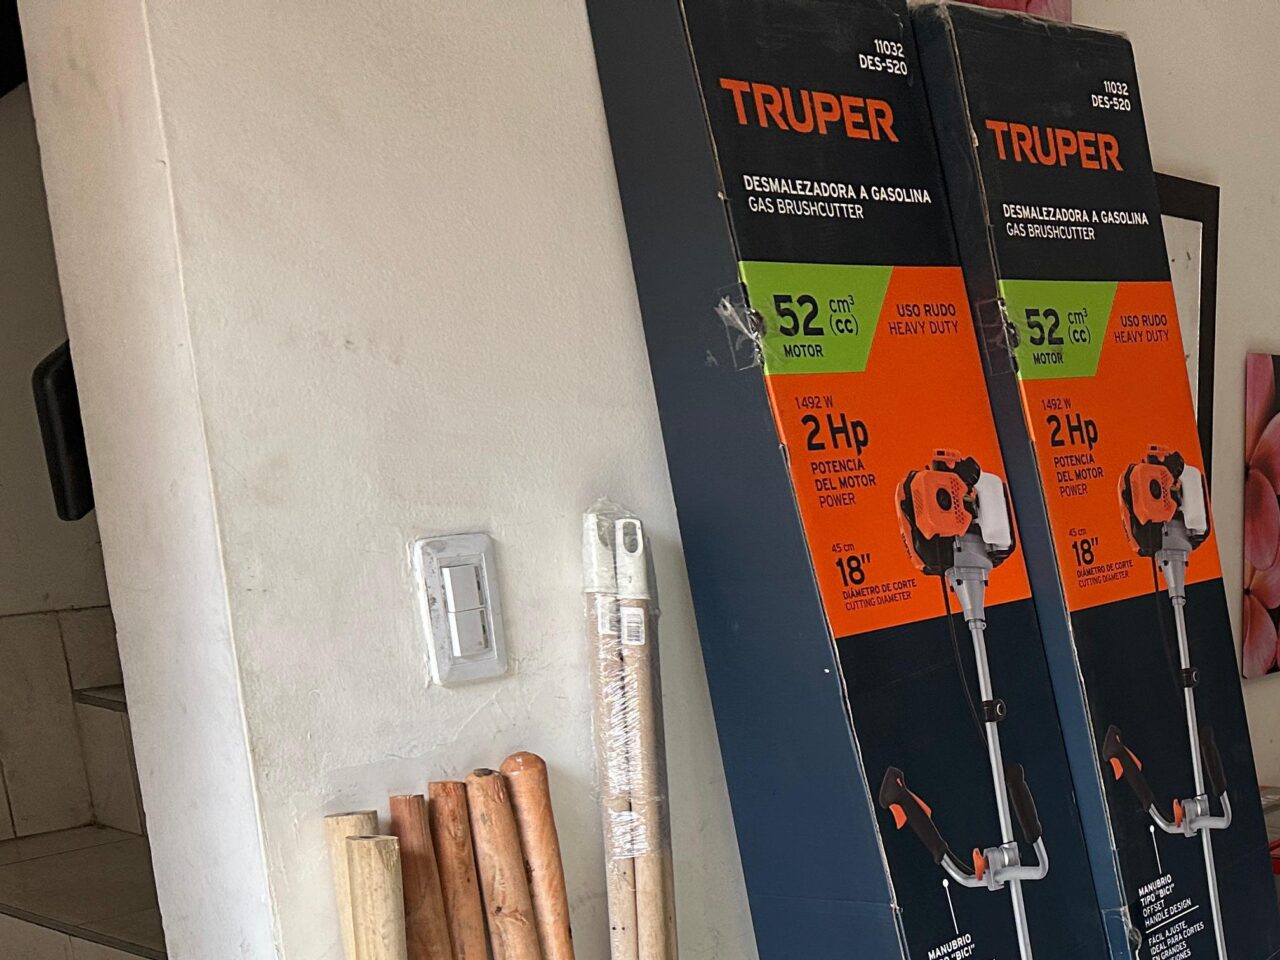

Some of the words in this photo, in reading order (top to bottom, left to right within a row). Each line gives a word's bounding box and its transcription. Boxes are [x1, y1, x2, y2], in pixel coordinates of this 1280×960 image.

[874, 39, 905, 58] 11032
[859, 54, 908, 75] DES-520
[1103, 80, 1129, 96] 11032
[719, 77, 900, 142] TRUPER
[1091, 94, 1132, 112] DES-520
[985, 119, 1124, 172] TRUPER
[743, 174, 855, 200] DESMALEZADORA
[859, 185, 869, 199] A
[871, 187, 932, 204] GASOLINA
[748, 196, 774, 213] GAS
[777, 198, 864, 219] BRUSHCUTTER
[1002, 203, 1089, 223] DESMALEZADORA
[1092, 210, 1099, 223] A
[1100, 211, 1149, 226] GASOLINA
[1006, 222, 1026, 237] GAS
[1028, 225, 1096, 240] BRUSHCUTTER
[773, 294, 825, 337] 52
[896, 303, 921, 317] USO
[924, 304, 956, 317] RUDO
[829, 316, 859, 337] (cc)
[889, 321, 926, 336] HEAVY
[930, 320, 959, 335] DUTY
[1025, 308, 1065, 346] 52
[1120, 313, 1139, 327] USO
[1142, 313, 1168, 327] RUDO
[1068, 327, 1091, 345] (cc)
[1114, 330, 1144, 344] HEAVY
[1146, 329, 1170, 342] DUTY
[784, 343, 824, 358] MOTOR
[1033, 351, 1064, 365] MOTOR
[795, 395, 822, 409] 1492
[823, 395, 833, 408] W
[1041, 397, 1063, 411] 1492
[1063, 397, 1072, 409] W
[810, 459, 865, 475] POTENCIA
[1053, 453, 1096, 468] POTENCIA
[815, 478, 837, 493] DEL
[838, 473, 877, 490] MOTOR
[1056, 471, 1074, 483] DEL
[1074, 466, 1104, 481] MOTOR
[1059, 483, 1089, 498] POWER
[819, 492, 857, 509] POWER
[831, 543, 843, 553] 45
[843, 543, 856, 552] cm
[1106, 562, 1115, 572] DE
[1115, 559, 1134, 571] CORTE
[881, 582, 893, 593] DE
[892, 578, 918, 592] CORTE
[1078, 575, 1102, 588] CUTTING
[1102, 570, 1129, 584] DIAMETER
[845, 596, 876, 611] CUTTING
[876, 591, 913, 608] DIAMETER
[1138, 874, 1171, 897] MANUBRIO
[1140, 893, 1156, 906] TIPO
[1142, 899, 1165, 917] OFFSET
[1145, 908, 1169, 928] HANDLE
[1169, 898, 1192, 915] DESIGN
[928, 934, 971, 960] MANUBRIO
[1150, 942, 1167, 956] IDEAL
[1167, 933, 1183, 946] PARA
[1182, 921, 1205, 938] CORTES
[1160, 941, 1187, 960] GRANDES
